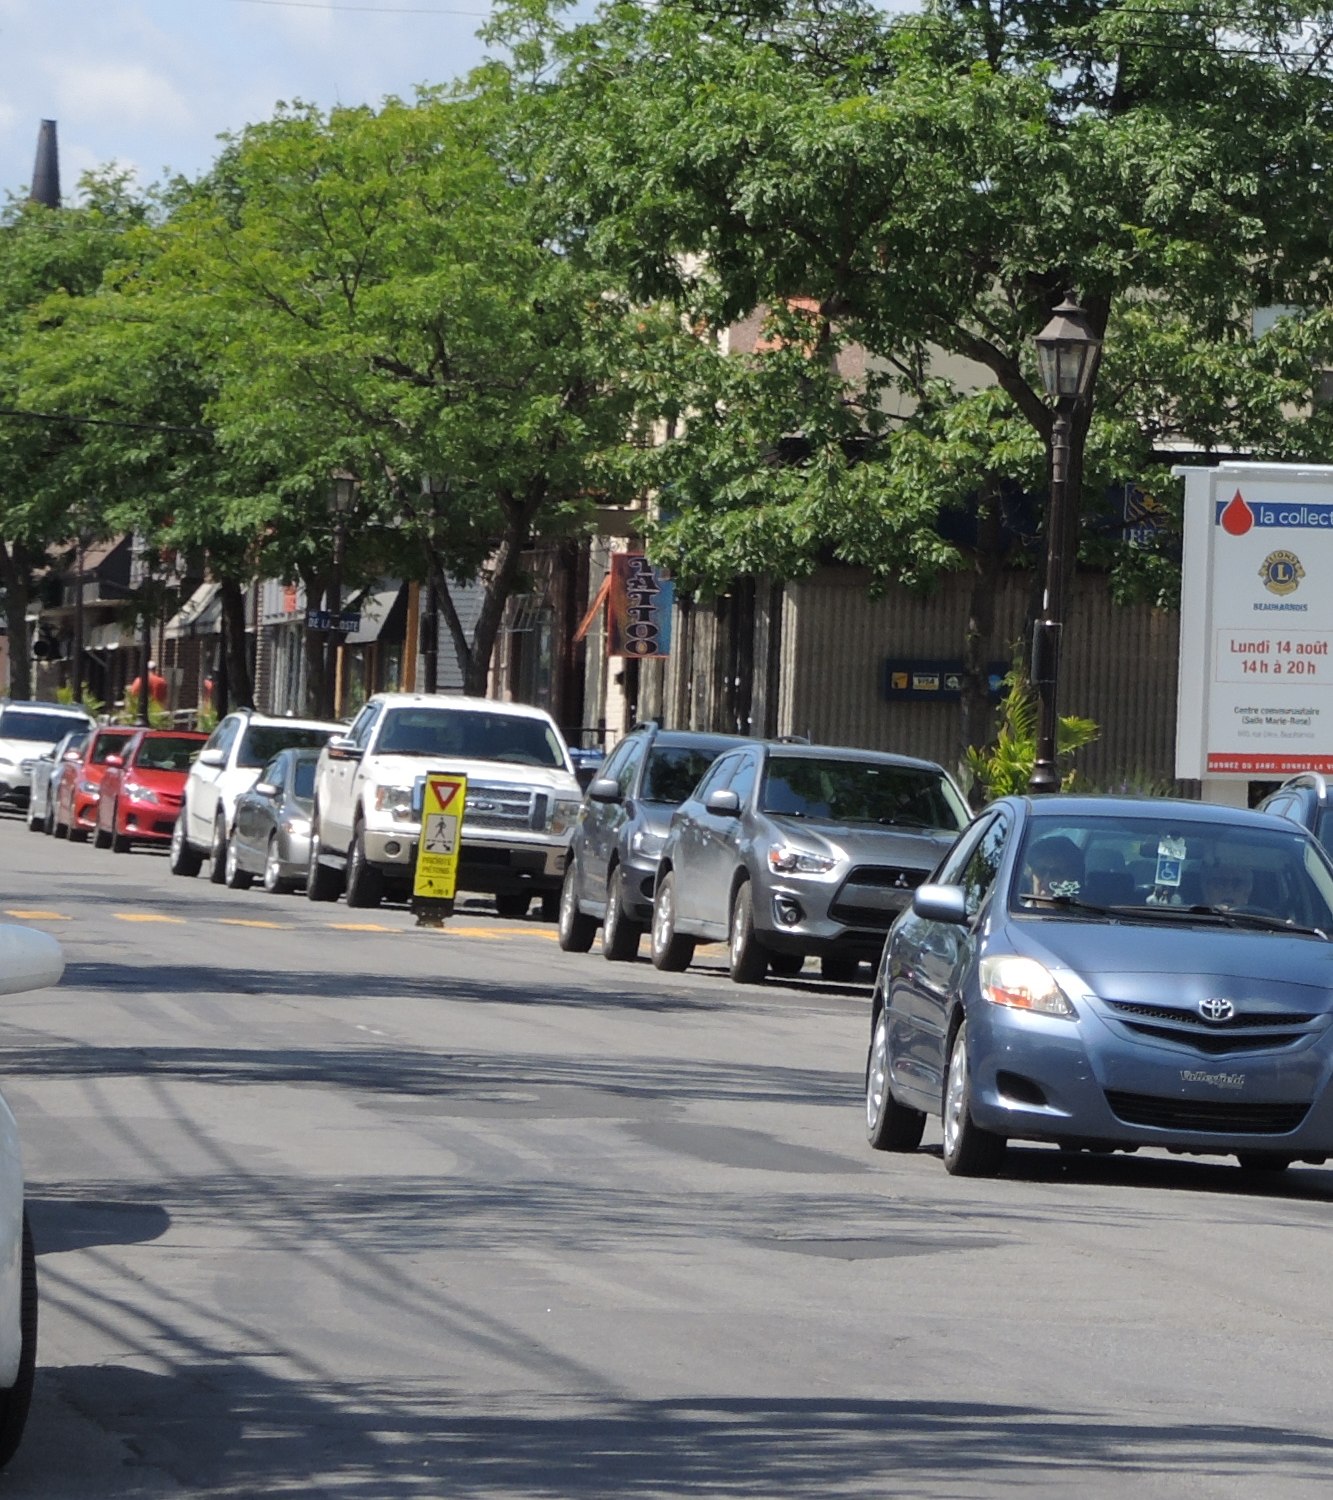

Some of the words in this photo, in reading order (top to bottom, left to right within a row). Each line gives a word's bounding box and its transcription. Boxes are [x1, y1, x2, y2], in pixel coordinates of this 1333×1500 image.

[1260, 506, 1274, 524] la
[1276, 564, 1289, 581] L
[624, 557, 661, 655] TATTOO
[1230, 639, 1270, 654] Lundi
[1276, 641, 1291, 654] 14
[1296, 641, 1328, 655] août
[1242, 660, 1256, 673] 14
[1260, 661, 1268, 673] h
[1273, 660, 1282, 674] à
[1287, 661, 1304, 674] 20
[1307, 661, 1316, 674] h
